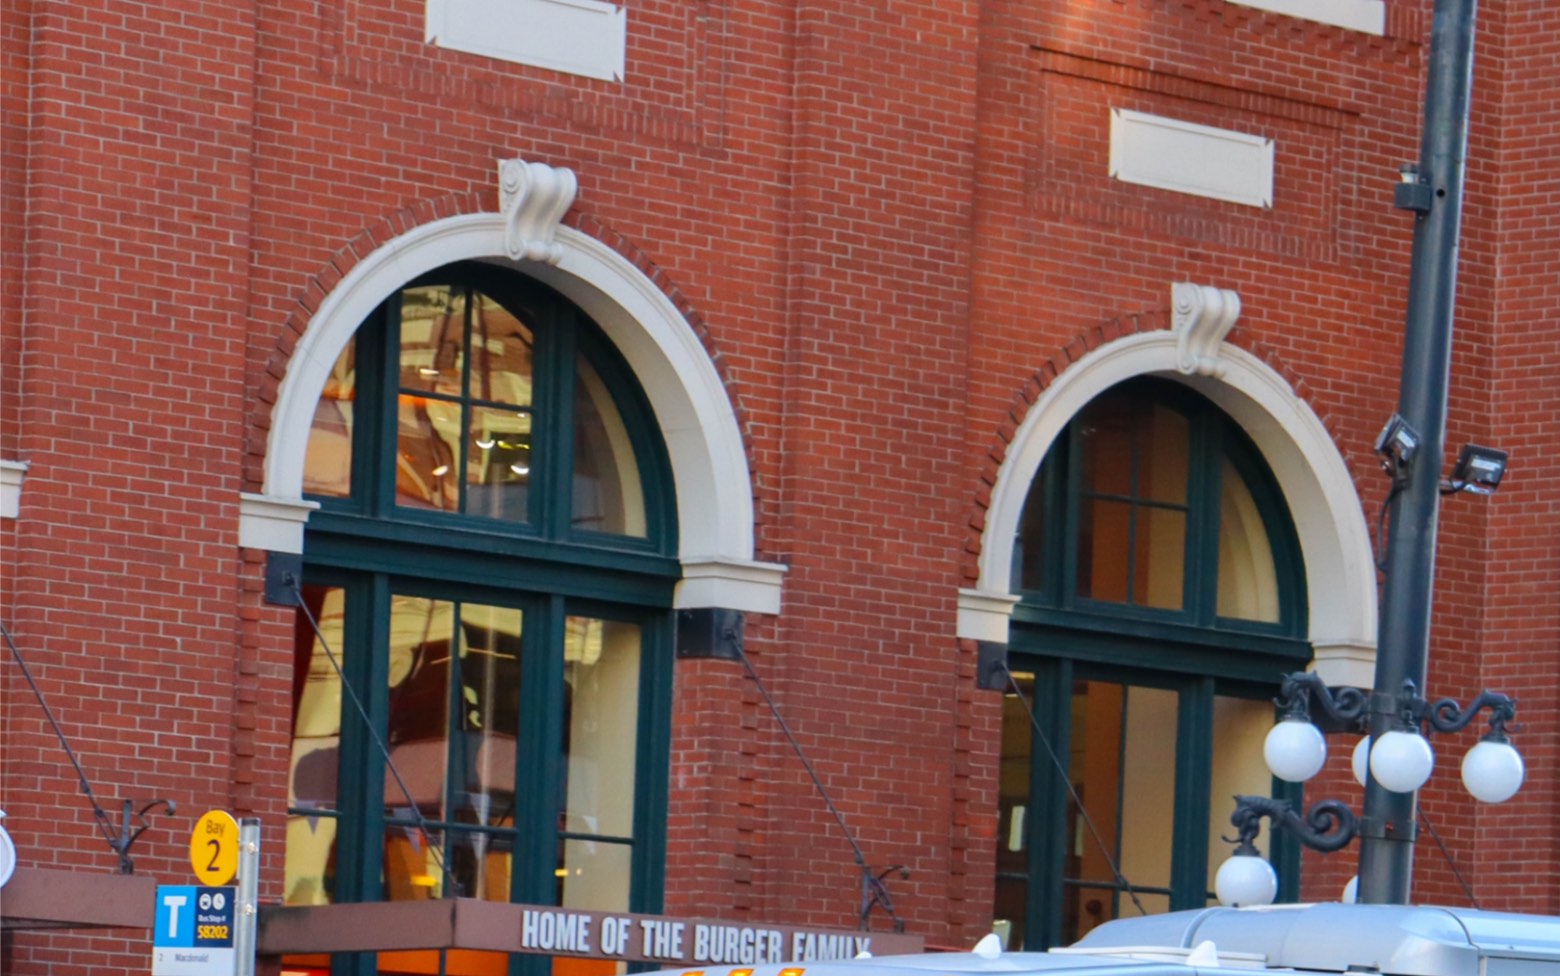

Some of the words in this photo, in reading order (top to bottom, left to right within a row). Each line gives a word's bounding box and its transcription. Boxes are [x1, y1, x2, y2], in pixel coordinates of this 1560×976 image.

[206, 819, 226, 837] Bay
[206, 839, 220, 871] 2
[163, 896, 187, 938] T
[521, 910, 591, 952] HOME
[600, 917, 631, 955] OF
[640, 920, 685, 959] THE
[694, 924, 782, 965] BURGER
[792, 932, 871, 962] FAMILY
